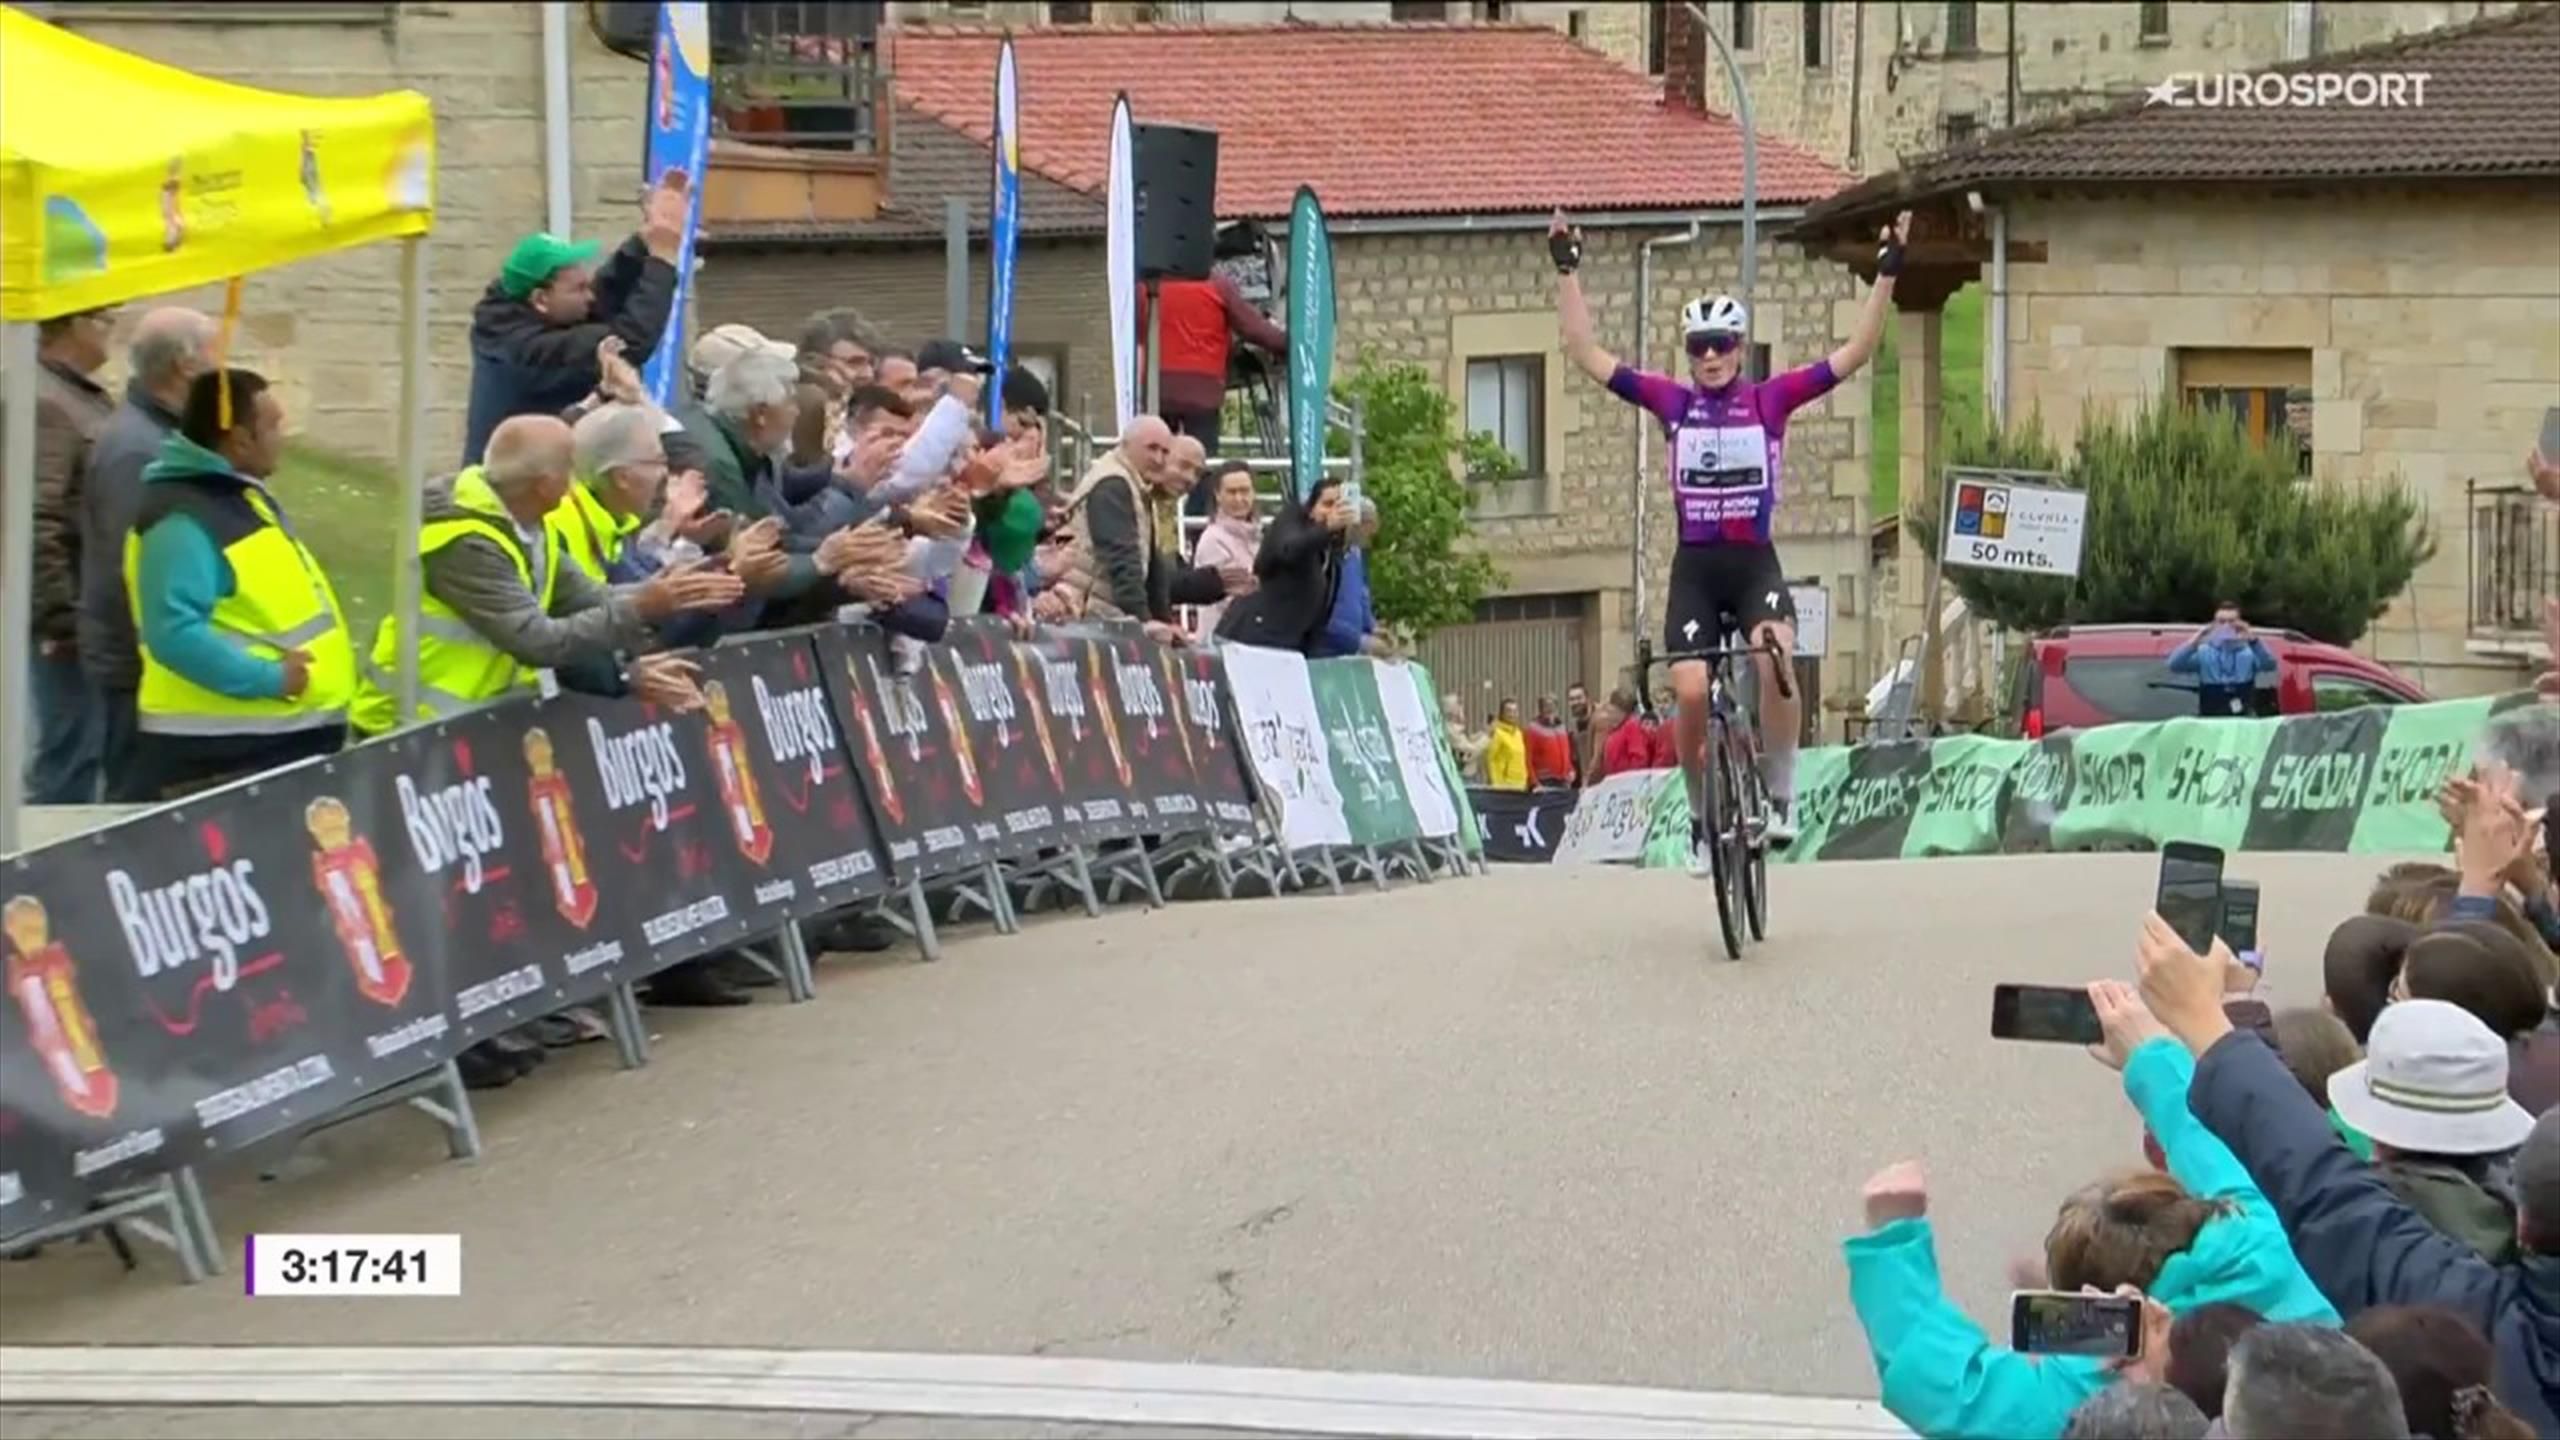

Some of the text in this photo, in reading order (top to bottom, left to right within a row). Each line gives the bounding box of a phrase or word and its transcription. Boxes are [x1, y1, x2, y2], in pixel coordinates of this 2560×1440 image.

[1971, 541, 2054, 568] 50 mts.
[586, 716, 688, 831] Burgos
[751, 674, 837, 785] Burgos
[395, 772, 504, 894] Burgos
[106, 857, 272, 992] Burgos
